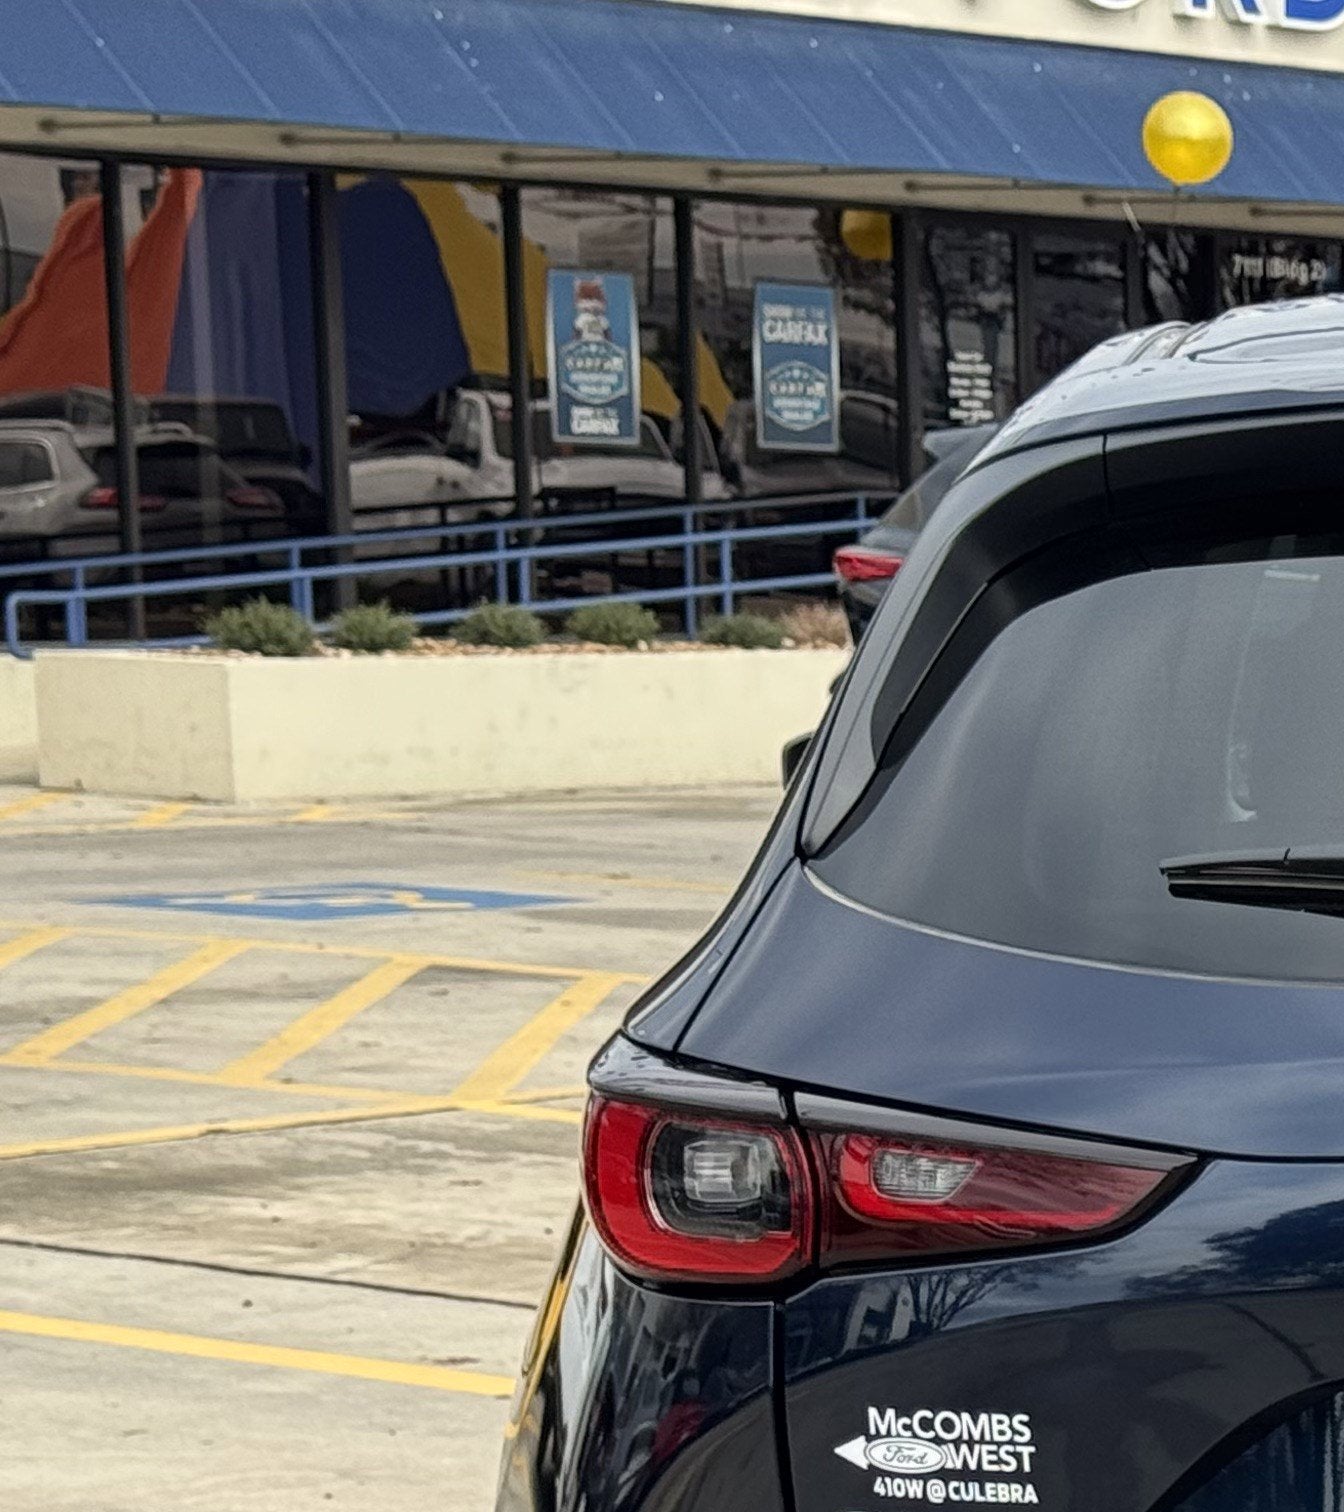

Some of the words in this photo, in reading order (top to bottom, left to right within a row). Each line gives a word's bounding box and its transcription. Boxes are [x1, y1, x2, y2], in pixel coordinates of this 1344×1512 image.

[867, 1406, 1032, 1443] McCOMBS
[883, 1445, 929, 1465] Ford
[950, 1443, 1036, 1473] WEST
